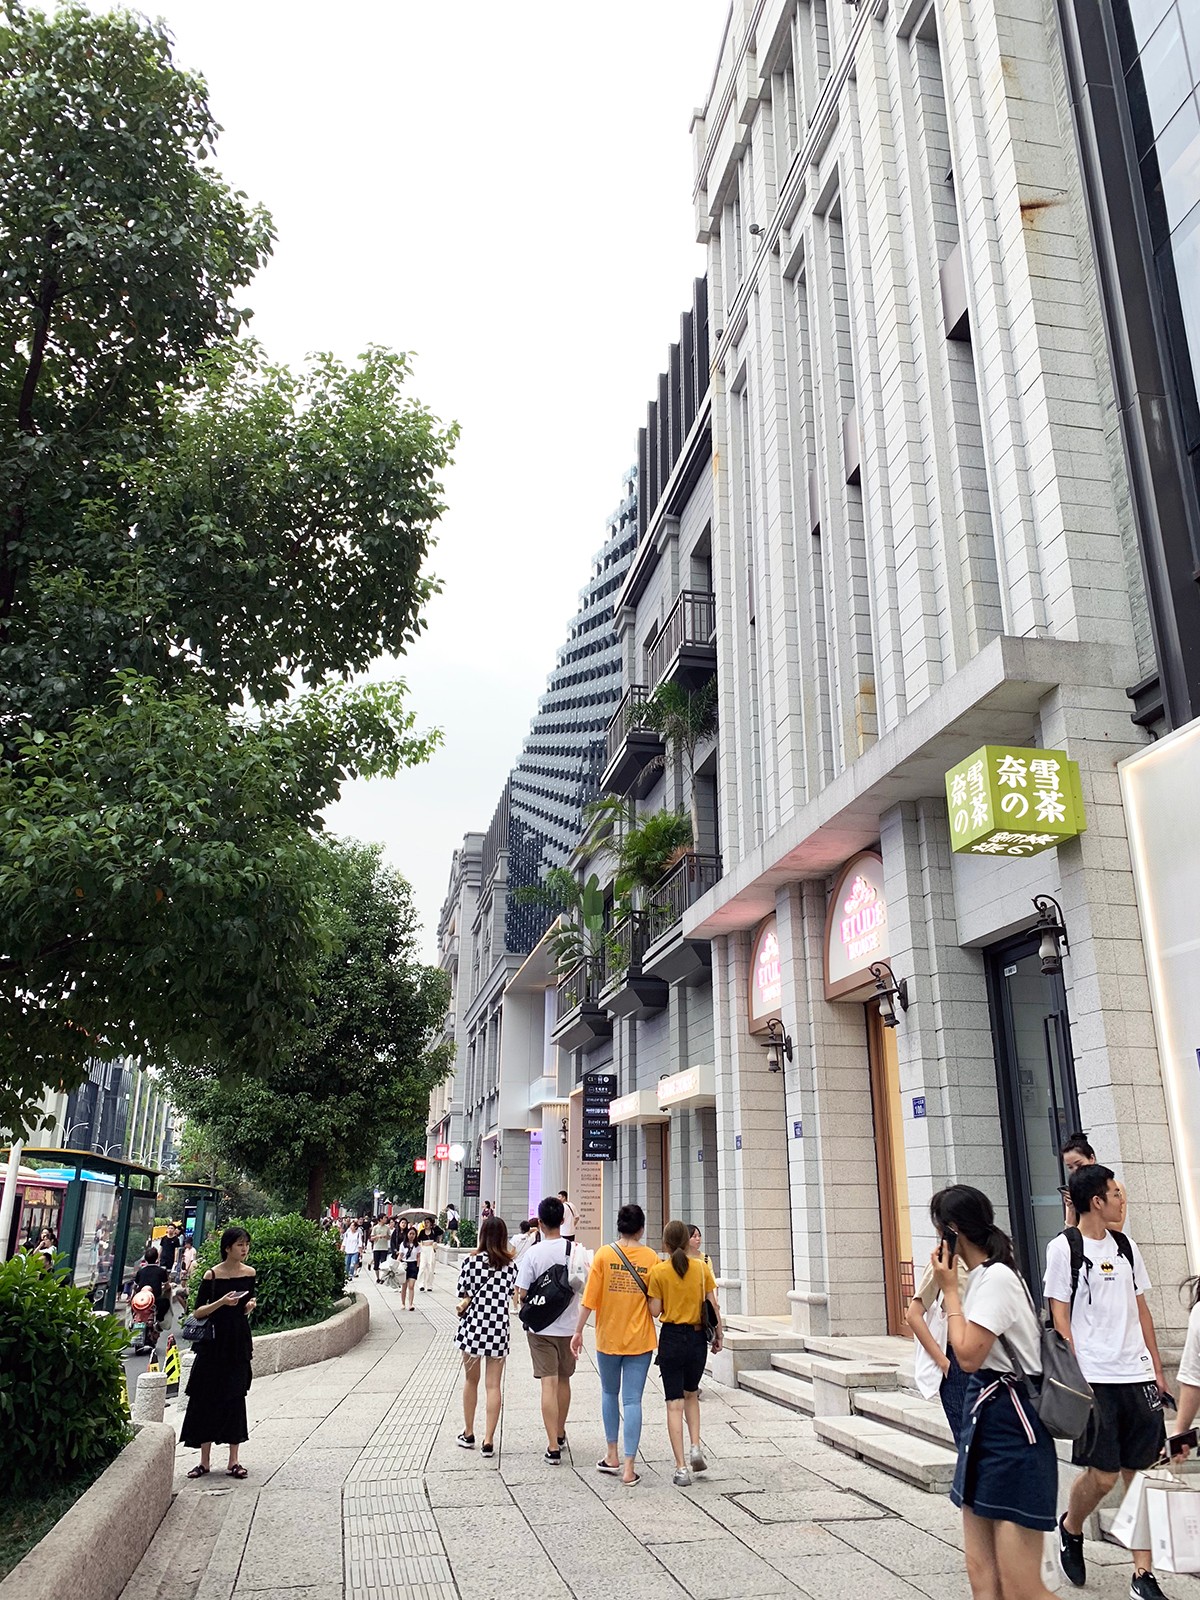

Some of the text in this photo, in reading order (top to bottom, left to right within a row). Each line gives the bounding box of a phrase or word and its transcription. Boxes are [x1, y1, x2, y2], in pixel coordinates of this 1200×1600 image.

[995, 754, 1061, 791] 奈雪
[1001, 789, 1067, 824] の茶
[840, 900, 887, 944] ETUDE
